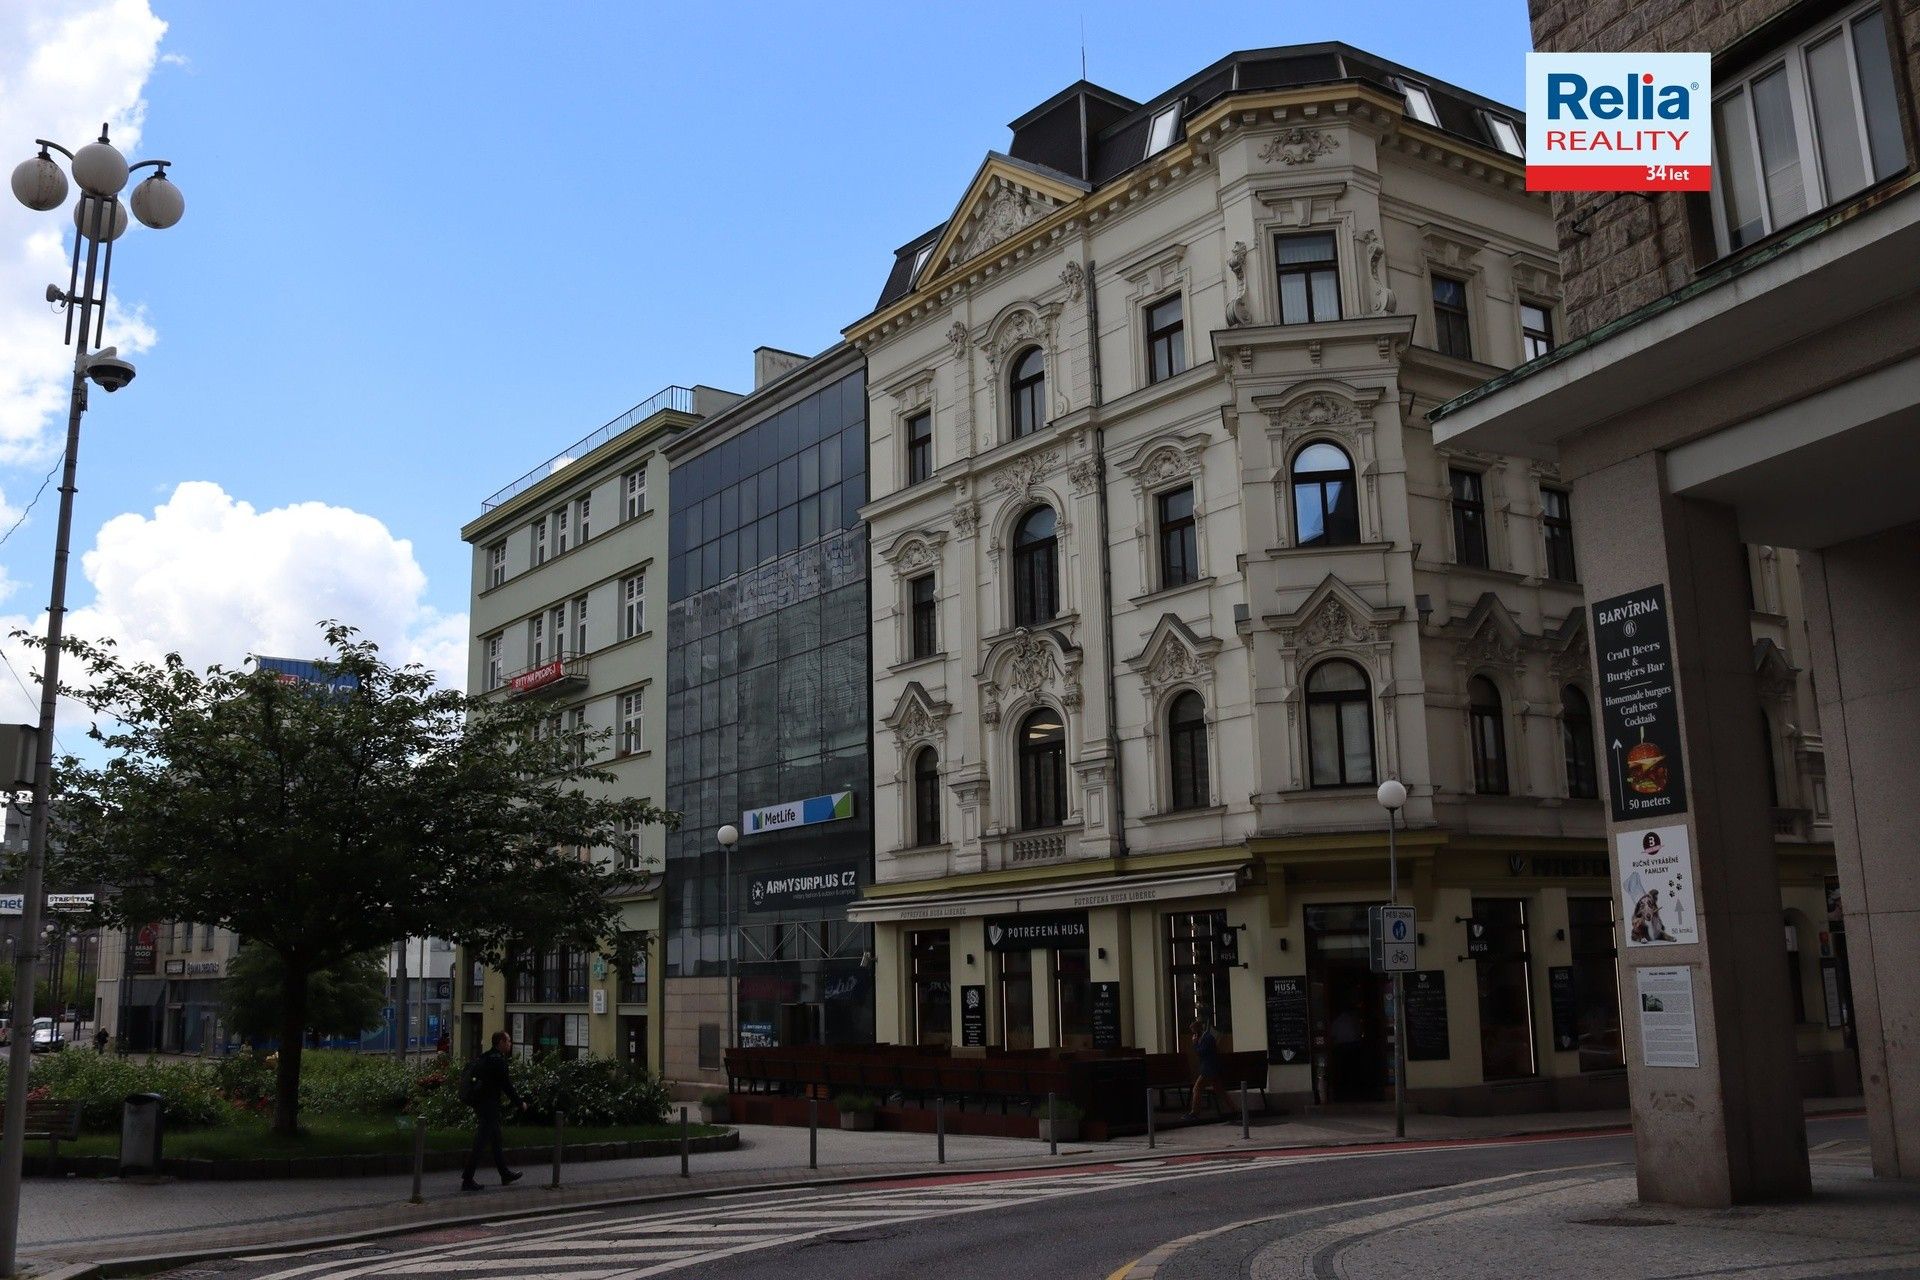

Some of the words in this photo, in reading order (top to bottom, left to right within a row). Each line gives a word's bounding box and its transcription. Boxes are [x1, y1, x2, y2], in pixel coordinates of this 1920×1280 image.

[1606, 647, 1631, 662] Craft
[1632, 641, 1661, 656] Beers
[1631, 656, 1639, 667] &
[1606, 665, 1646, 683] Burgers
[1647, 662, 1666, 674] Bar
[1605, 690, 1644, 707] Homemade
[1644, 685, 1672, 700] burgers
[1620, 703, 1638, 716] Craft
[1639, 701, 1658, 712] beers
[1624, 713, 1657, 727] Cocktails
[1628, 798, 1639, 810] 50
[1641, 796, 1672, 808] meters
[765, 809, 796, 825] MetLife
[766, 874, 839, 895] ARMYSURPLUS
[841, 871, 856, 887] CZ
[1061, 923, 1085, 936] HUSA
[1470, 944, 1488, 952] HUSA
[1274, 983, 1297, 991] HUSA
